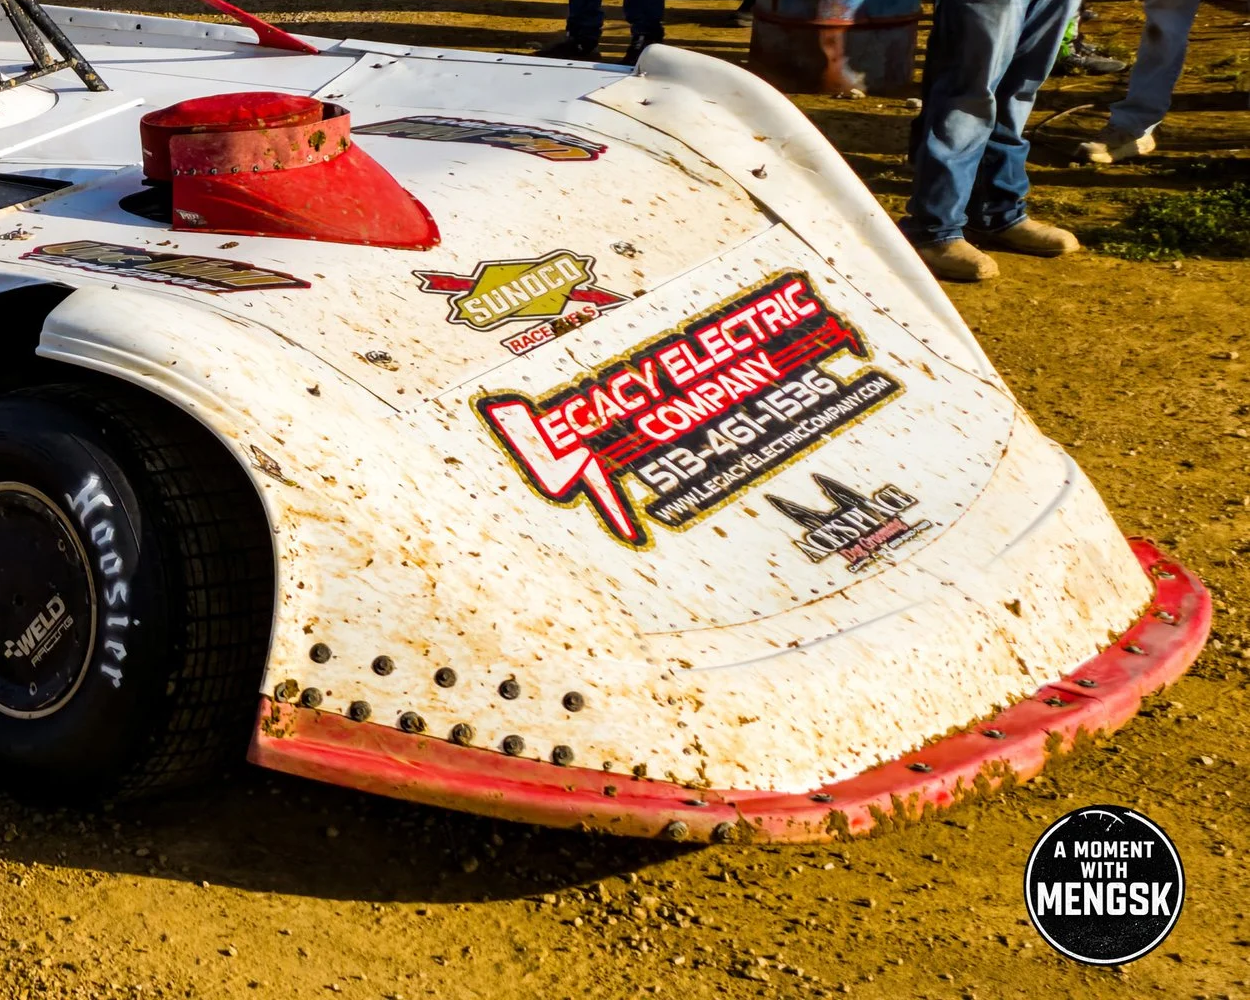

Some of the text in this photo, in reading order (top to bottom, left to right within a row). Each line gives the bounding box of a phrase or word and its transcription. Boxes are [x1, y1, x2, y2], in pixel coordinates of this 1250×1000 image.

[462, 257, 584, 324] SUNOCO
[508, 326, 551, 353] RACE
[492, 282, 817, 520] LEGACY ELECTRIC
[638, 351, 781, 441] COMPANY
[638, 370, 837, 492] 513-461-1536
[64, 473, 141, 689] Hoosier
[16, 595, 67, 657] WELD
[31, 614, 74, 668] RACING
